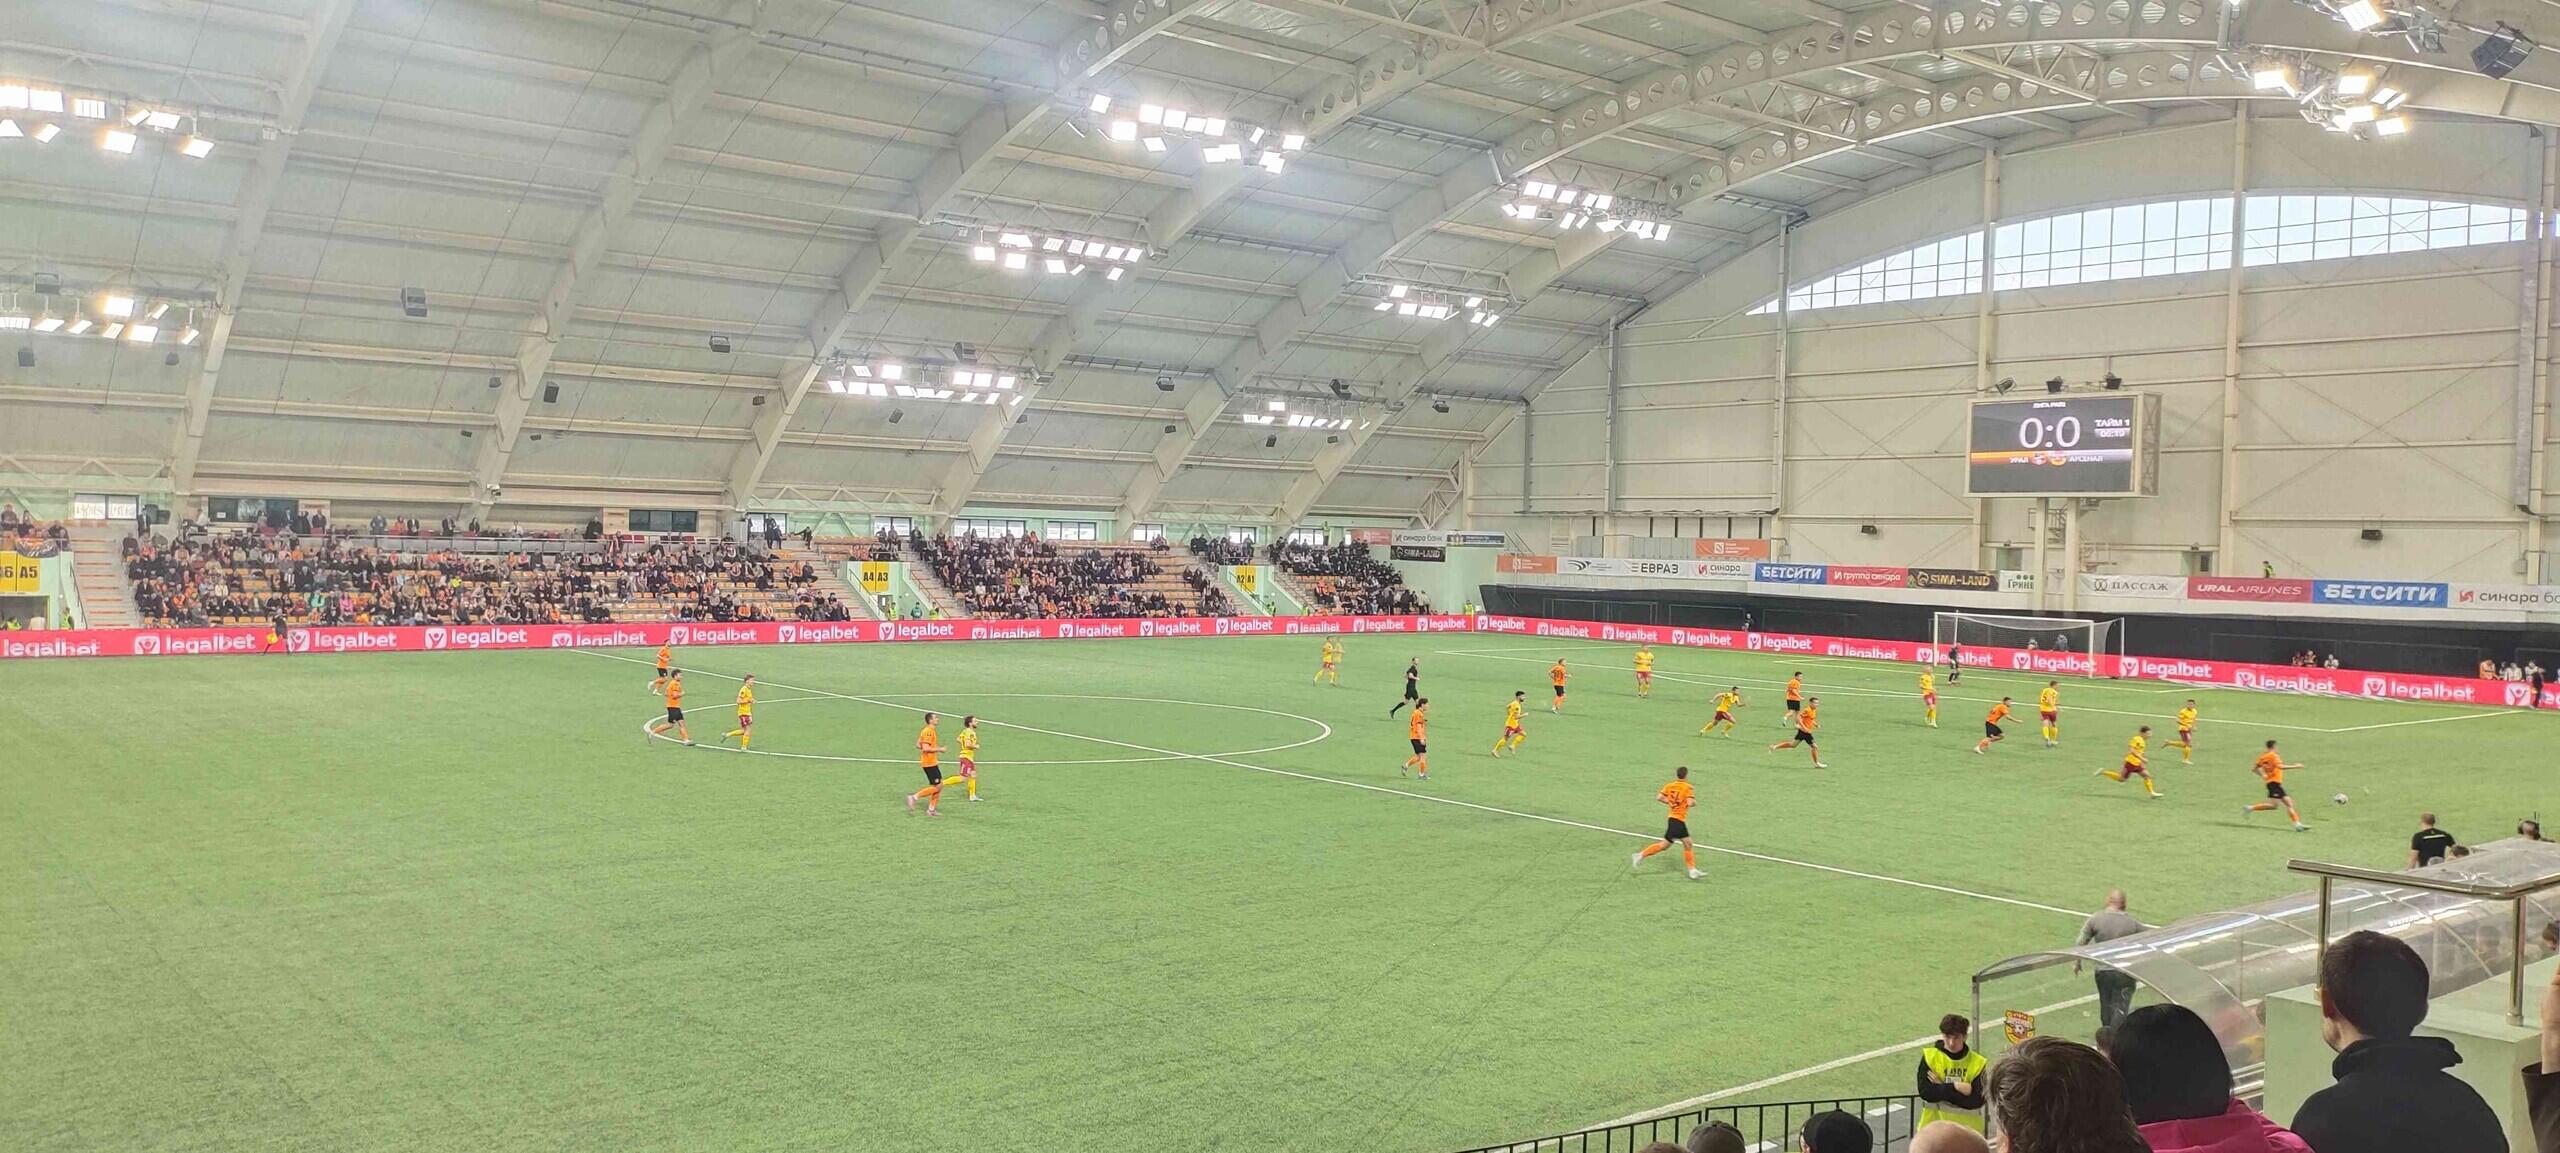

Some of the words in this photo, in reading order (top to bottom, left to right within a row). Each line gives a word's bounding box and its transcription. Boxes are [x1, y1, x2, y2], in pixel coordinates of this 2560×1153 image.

[2019, 416, 2081, 448] 0:0
[20, 566, 37, 578] A5
[1641, 563, 1679, 574] ЕВРАЗ
[1710, 564, 1741, 572] синара
[1762, 566, 1822, 580] БЕТСИТИ
[863, 572, 874, 581] A4
[877, 572, 888, 581] A3
[1929, 575, 1990, 586] SIMA-LAND
[2112, 581, 2169, 591] ПАССАЖ
[2197, 585, 2235, 593] URAL
[2235, 585, 2302, 596] AIRLINES
[2323, 584, 2437, 600] БЕТСИТИ
[2479, 592, 2539, 605] синара
[898, 622, 954, 640] legalbet
[1076, 623, 1125, 637] legalbet
[1155, 620, 1201, 635] legalbet
[1230, 618, 1273, 633] legalbet
[1429, 617, 1466, 631] legalbet
[1489, 616, 1526, 631] legalbet
[315, 631, 397, 651] legalbet
[451, 628, 527, 648] legalbet
[800, 625, 859, 642] legalbet
[1687, 630, 1732, 647] legalbet
[166, 632, 256, 653] legalbet
[1763, 634, 1813, 651] legalbet
[1936, 650, 1994, 667] lealbet
[2142, 659, 2212, 678] legalbet
[2390, 680, 2475, 702] legalbet
